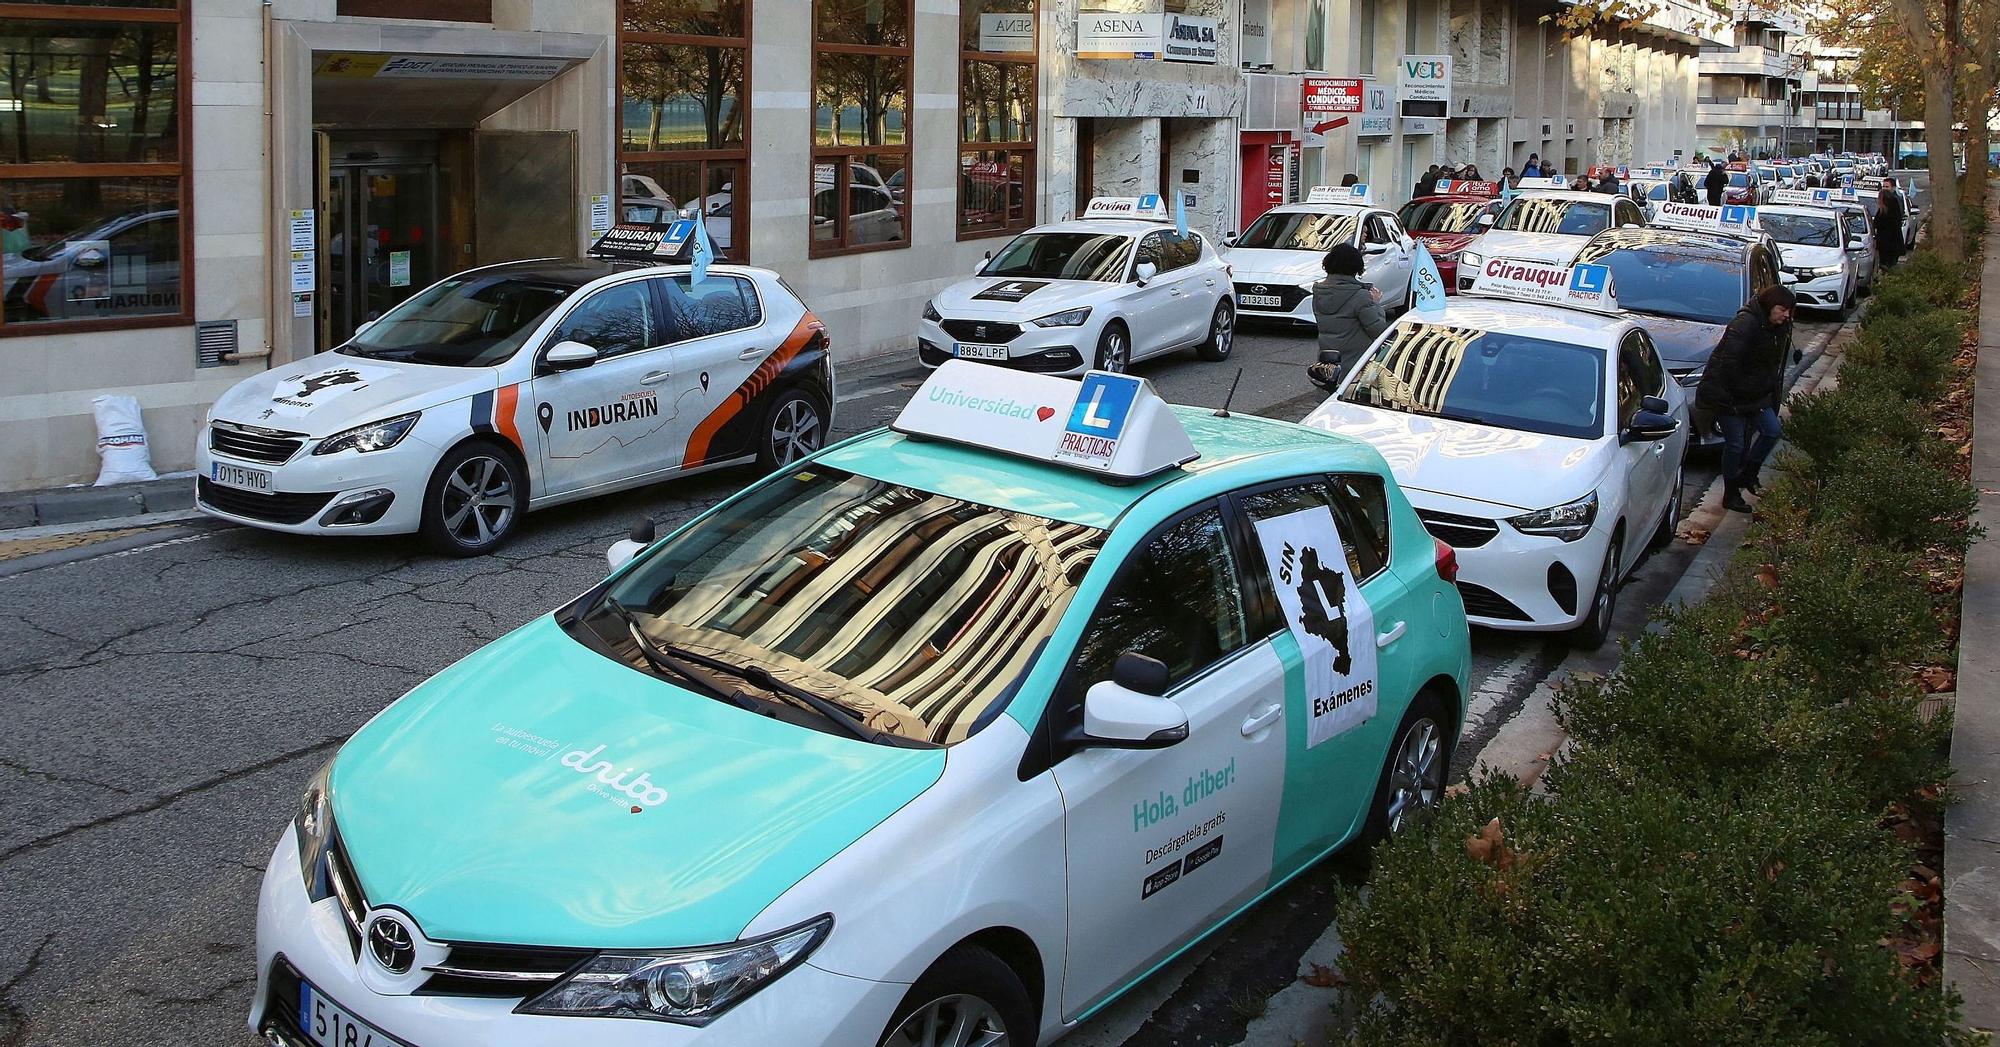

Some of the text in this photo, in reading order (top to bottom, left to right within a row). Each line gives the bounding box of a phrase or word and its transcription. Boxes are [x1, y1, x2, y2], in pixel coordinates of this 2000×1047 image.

[1093, 20, 1143, 32] ASENA
[403, 61, 431, 69] DGT
[1406, 61, 1445, 79] VC13
[1317, 86, 1347, 95] MÉDICOS
[1196, 95, 1204, 109] 11
[1306, 95, 1360, 105] CONDUCTORES
[1353, 186, 1362, 195] L
[1816, 192, 1824, 201] L
[1844, 186, 1852, 195] L
[1091, 201, 1132, 212] Orvina
[1142, 197, 1152, 208] L
[1662, 202, 1719, 221] Cirauqui
[1726, 208, 1739, 222] L
[606, 228, 666, 242] INDURAIN
[669, 223, 683, 241] L
[1418, 267, 1438, 286] DGT
[1486, 259, 1569, 288] Cirauqui
[1578, 268, 1595, 289] L
[1241, 295, 1281, 306] 2132 LSG
[1567, 290, 1601, 301] PRACTICAS
[960, 345, 1005, 359] 8894 LPF
[621, 390, 657, 402] AUTOESCUELA
[929, 385, 1036, 421] Universidad
[567, 396, 659, 432] INDURAIN
[1083, 384, 1111, 429] L
[1060, 433, 1116, 457] PRACTICAS
[219, 465, 268, 489] 0115 HYD
[1279, 541, 1296, 585] SIN
[1313, 679, 1373, 718] Exámenes
[503, 726, 560, 750] autoescuela
[560, 743, 669, 806] dribo
[609, 795, 629, 809] with
[1133, 756, 1235, 833] Hola, driber!
[1145, 810, 1226, 865] Descárgatela gratis
[1194, 852, 1211, 865] Google
[1152, 878, 1165, 889] App
[1164, 870, 1179, 883] Store
